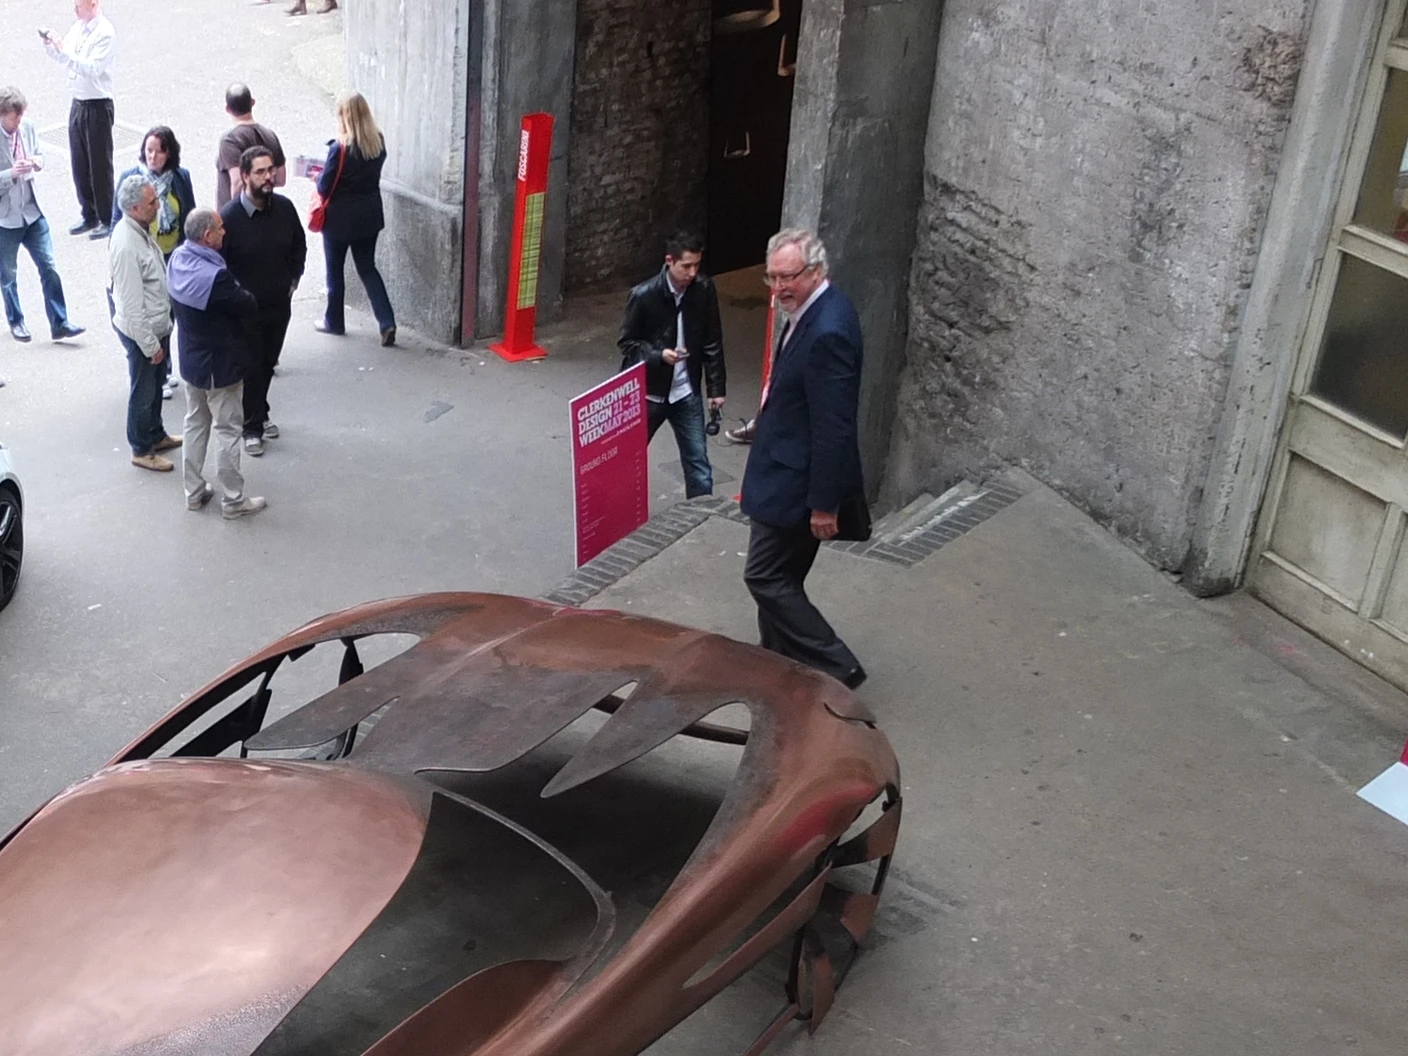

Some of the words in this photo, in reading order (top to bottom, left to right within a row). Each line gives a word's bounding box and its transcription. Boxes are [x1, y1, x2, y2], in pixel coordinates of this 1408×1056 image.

[518, 129, 529, 182] FOSCARINI
[577, 378, 640, 421] CLERKENWELL
[578, 406, 612, 435] DESIGN
[613, 400, 623, 416] 21
[630, 390, 640, 406] 23
[579, 425, 605, 447] WEEK
[603, 412, 623, 433] MAY
[623, 403, 641, 423] 2013
